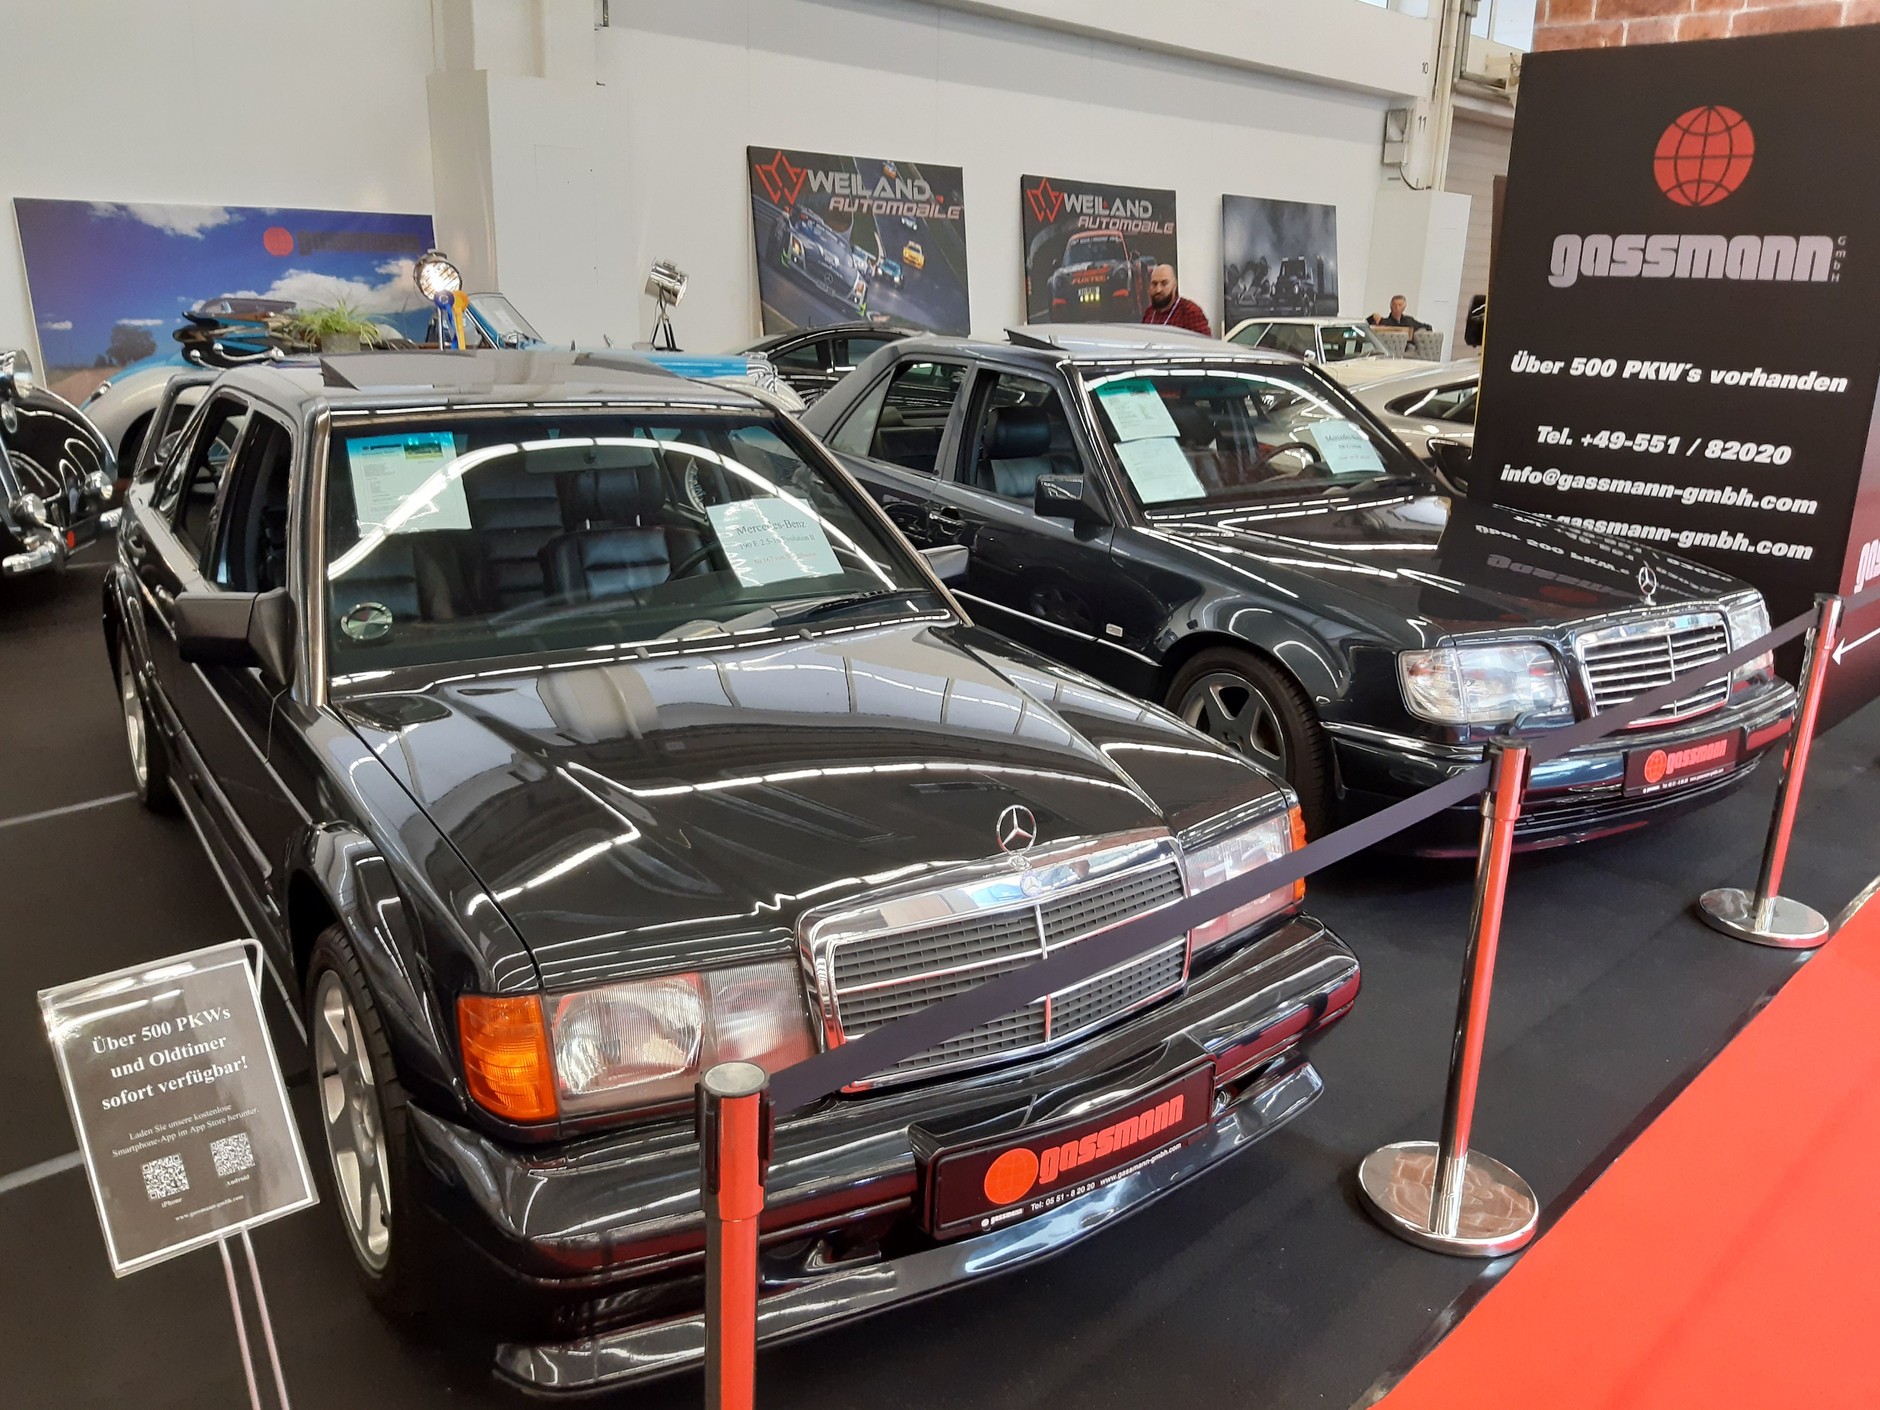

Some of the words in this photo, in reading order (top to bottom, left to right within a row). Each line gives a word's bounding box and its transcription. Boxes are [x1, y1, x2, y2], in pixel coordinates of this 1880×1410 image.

[1422, 62, 1429, 74] 10
[1418, 115, 1427, 132] 11
[807, 169, 932, 201] WEILAND
[1064, 192, 1153, 219] WEILAND
[829, 197, 963, 220] AUTOMOBILE
[1078, 215, 1175, 234] AUTOMOBILE
[1548, 234, 1834, 288] gassmann
[1831, 235, 1847, 283] GmbH
[1510, 350, 1565, 376] Über
[1569, 357, 1617, 378] 500
[1710, 367, 1848, 393] vorhanden
[1537, 425, 1573, 446] Tel.
[1581, 430, 1680, 455] +49-551
[1685, 438, 1702, 456] /
[1704, 439, 1792, 465] 82020
[1500, 464, 1818, 515] info@gassmann-gmbh.com
[92, 1033, 137, 1054] Über
[141, 1021, 172, 1042] 500
[175, 1006, 231, 1032] PKWs
[110, 1056, 145, 1078] und
[148, 1036, 227, 1067] Oldtimer
[101, 1083, 155, 1110] sofort
[157, 1055, 248, 1093] verfügbar!
[112, 1132, 177, 1158] Smartphone-App
[177, 1128, 188, 1138] im
[190, 1123, 206, 1135] App
[206, 1116, 226, 1128] Store
[227, 1107, 260, 1122] herunter.
[129, 1128, 153, 1140] Laden
[154, 1123, 167, 1134] Sie
[168, 1116, 193, 1129] unsere
[193, 1104, 232, 1121] kostenlose
[1039, 1094, 1184, 1184] gassmann
[1031, 1201, 1044, 1211] Tel:
[1045, 1197, 1055, 1206] 05
[1055, 1193, 1065, 1203] 51
[1076, 1185, 1085, 1195] 20
[1086, 1181, 1096, 1192] 20
[1100, 1143, 1182, 1185] www.gassmann-gmbh.com
